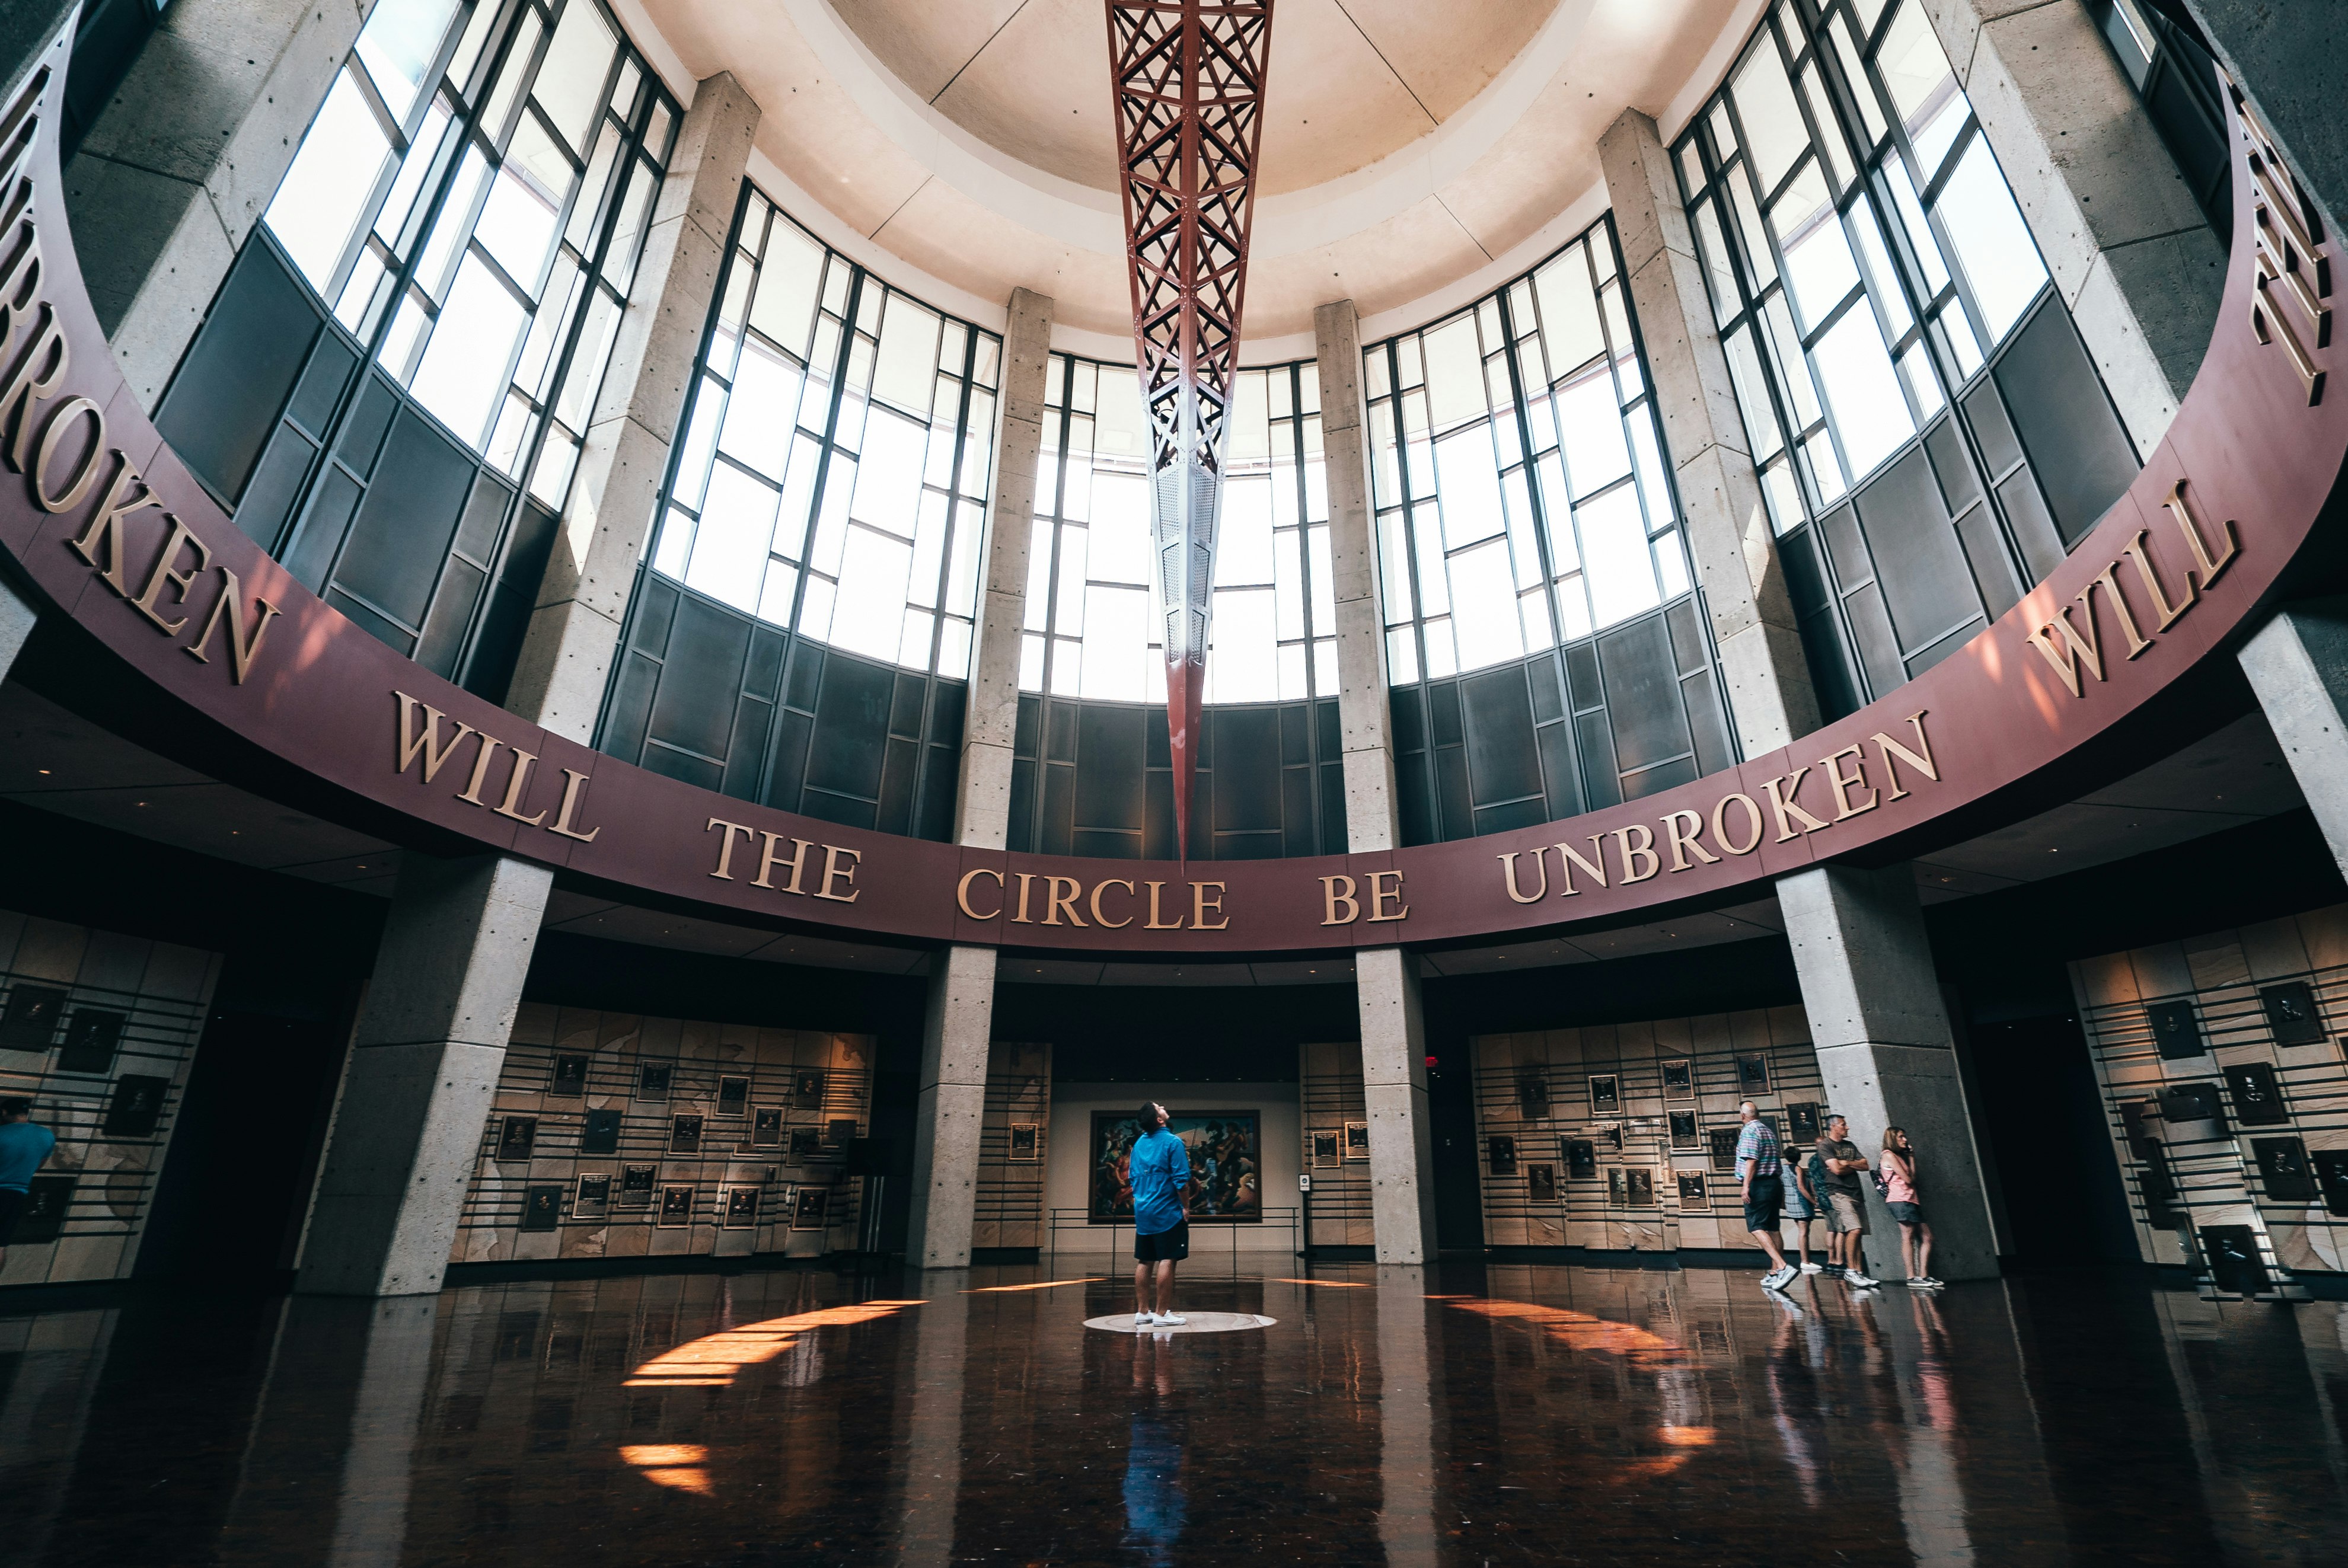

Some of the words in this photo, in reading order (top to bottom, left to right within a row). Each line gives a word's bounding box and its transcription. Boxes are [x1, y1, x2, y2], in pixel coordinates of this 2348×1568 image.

[394, 690, 601, 843] WILL
[707, 817, 861, 903] THE
[956, 868, 1230, 930] CIRCLE
[1318, 869, 1409, 926] BE
[1497, 709, 1940, 904] UNBROKEN
[2027, 478, 2241, 698] WILL
